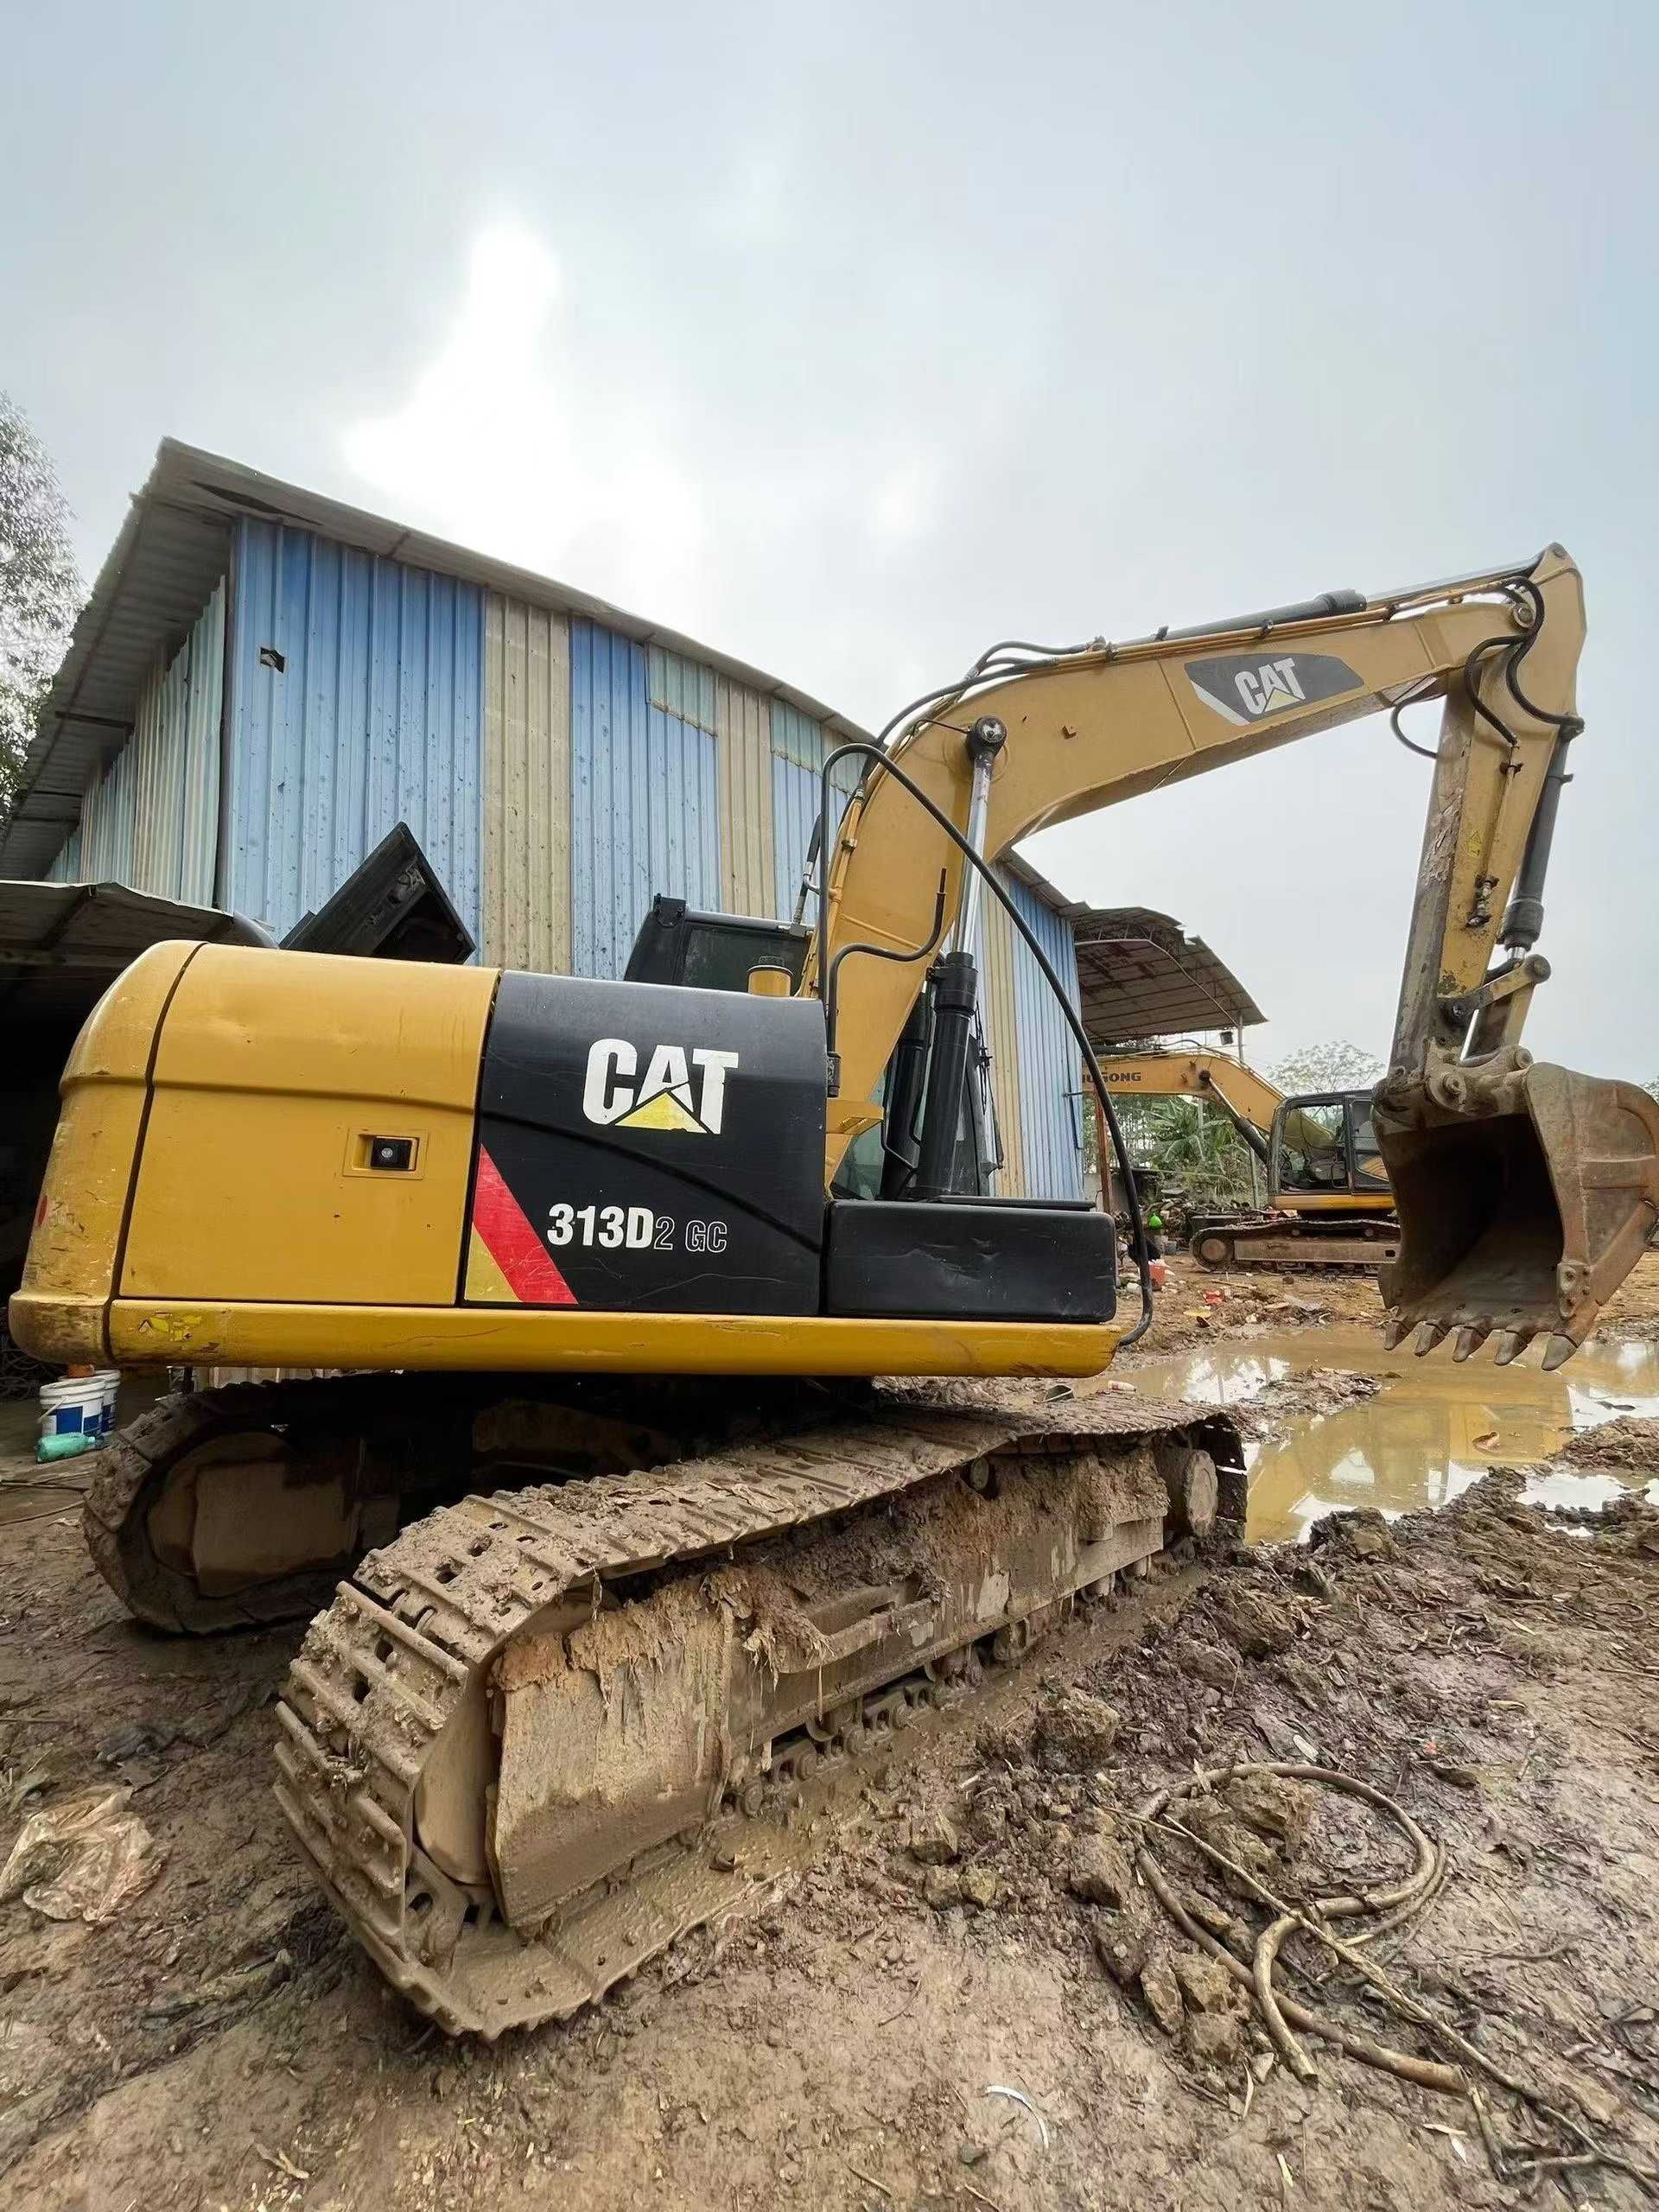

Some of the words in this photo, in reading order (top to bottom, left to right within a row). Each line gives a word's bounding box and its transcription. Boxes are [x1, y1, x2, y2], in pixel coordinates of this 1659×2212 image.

[1234, 658, 1306, 715] CAT
[582, 1039, 739, 1135] CAT
[547, 1203, 675, 1250] 313D2
[685, 1220, 728, 1253] GC
